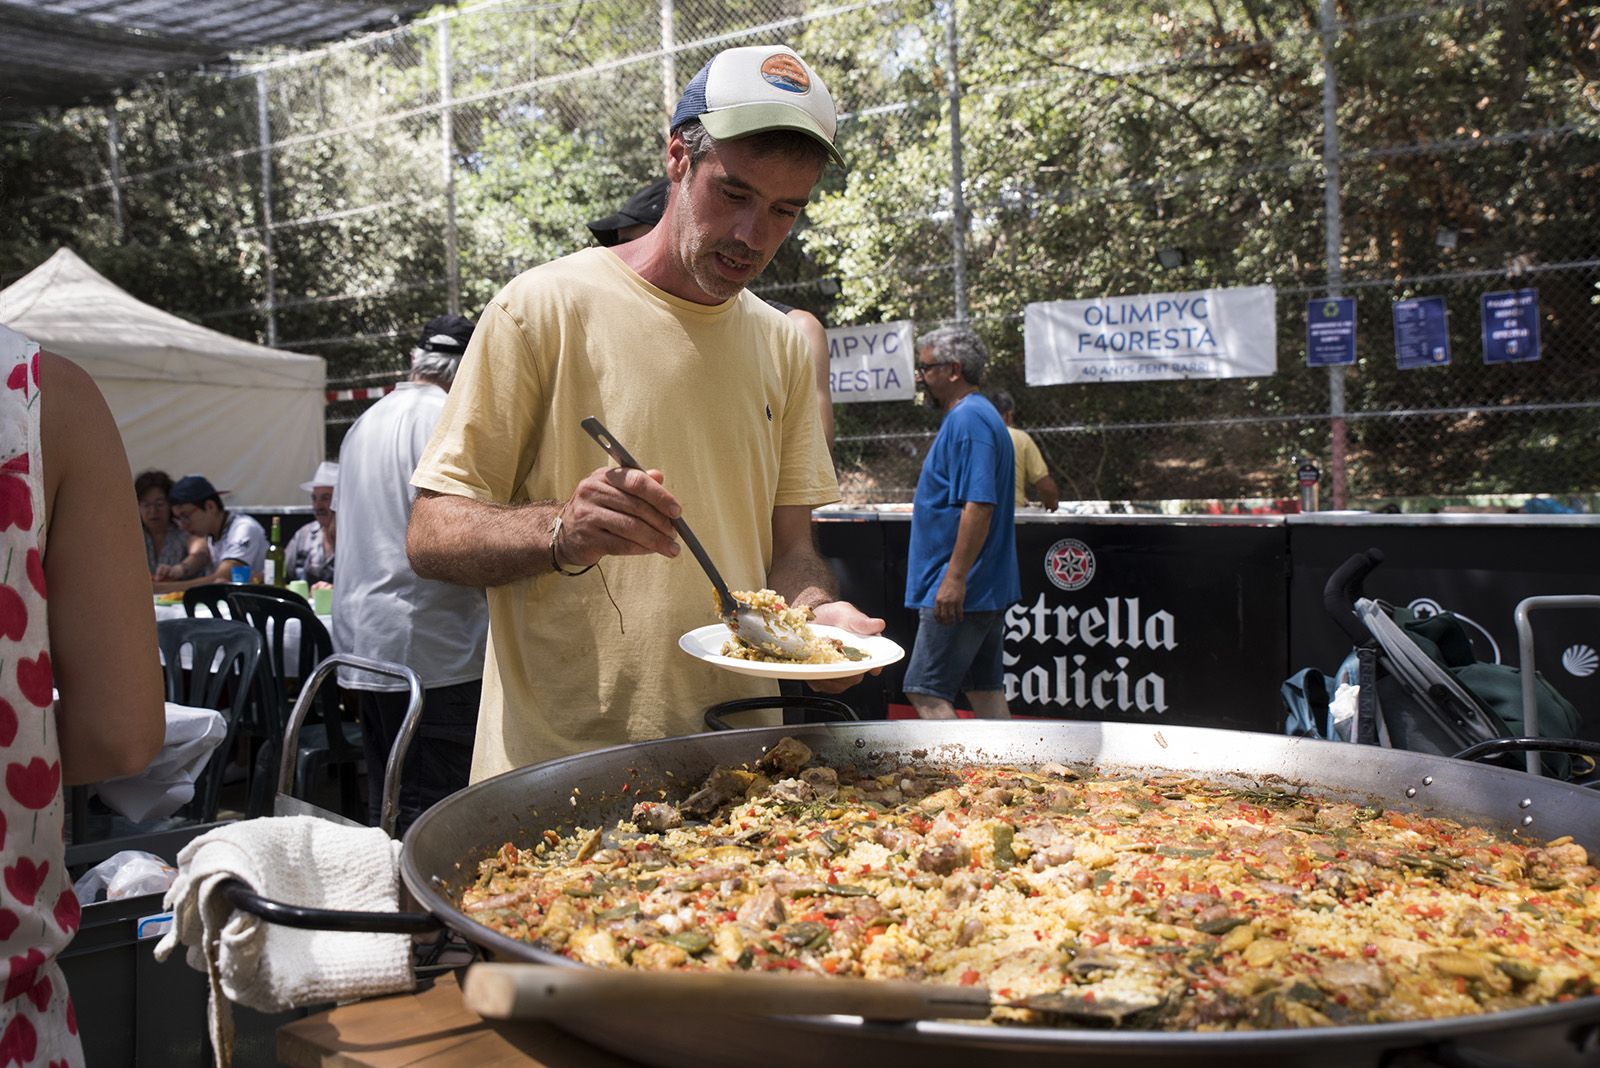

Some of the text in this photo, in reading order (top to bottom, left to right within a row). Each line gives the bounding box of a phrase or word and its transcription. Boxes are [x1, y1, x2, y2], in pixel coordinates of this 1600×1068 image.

[1083, 297, 1209, 326] OLIMPYC
[1078, 327, 1217, 353] F40RESTA
[1081, 365, 1097, 376] 40
[1137, 363, 1168, 374] FENT
[1002, 592, 1179, 652] strella
